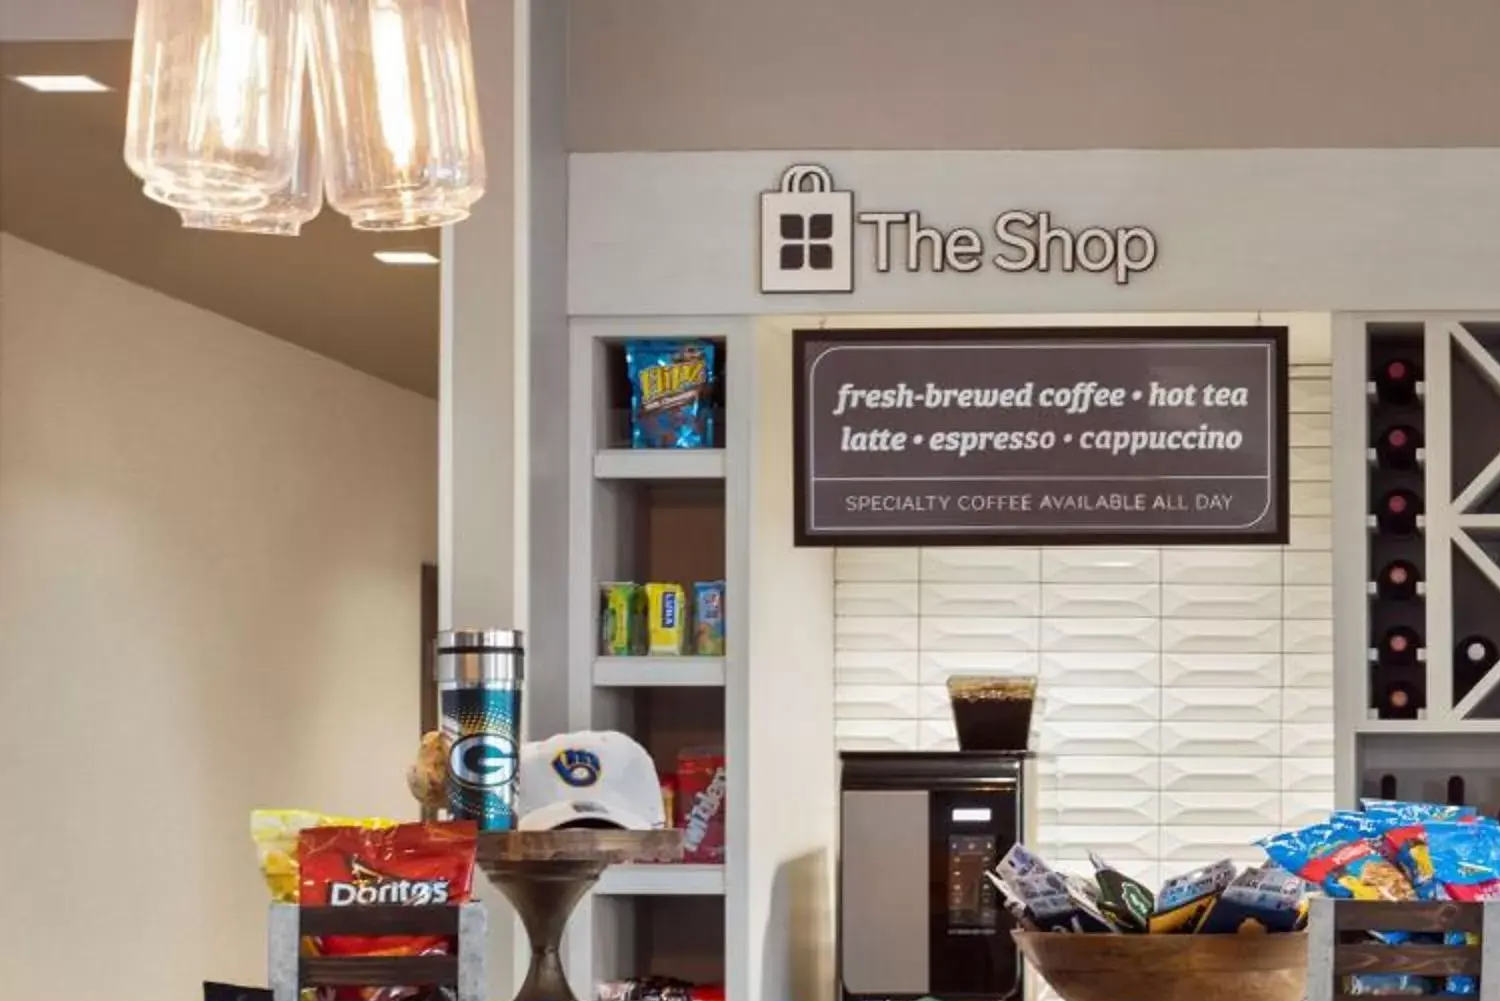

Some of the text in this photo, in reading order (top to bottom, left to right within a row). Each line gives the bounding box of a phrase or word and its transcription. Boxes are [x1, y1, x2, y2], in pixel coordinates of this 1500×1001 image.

[858, 210, 1156, 284] The Shop
[832, 381, 1249, 416] fresh-brewed coffee hot tea
[840, 425, 1244, 456] latte espresso cappuccino
[845, 494, 1233, 512] SPECIALTY COFFEE AVAILABLE ALL DAY
[330, 878, 449, 906] Doritos
